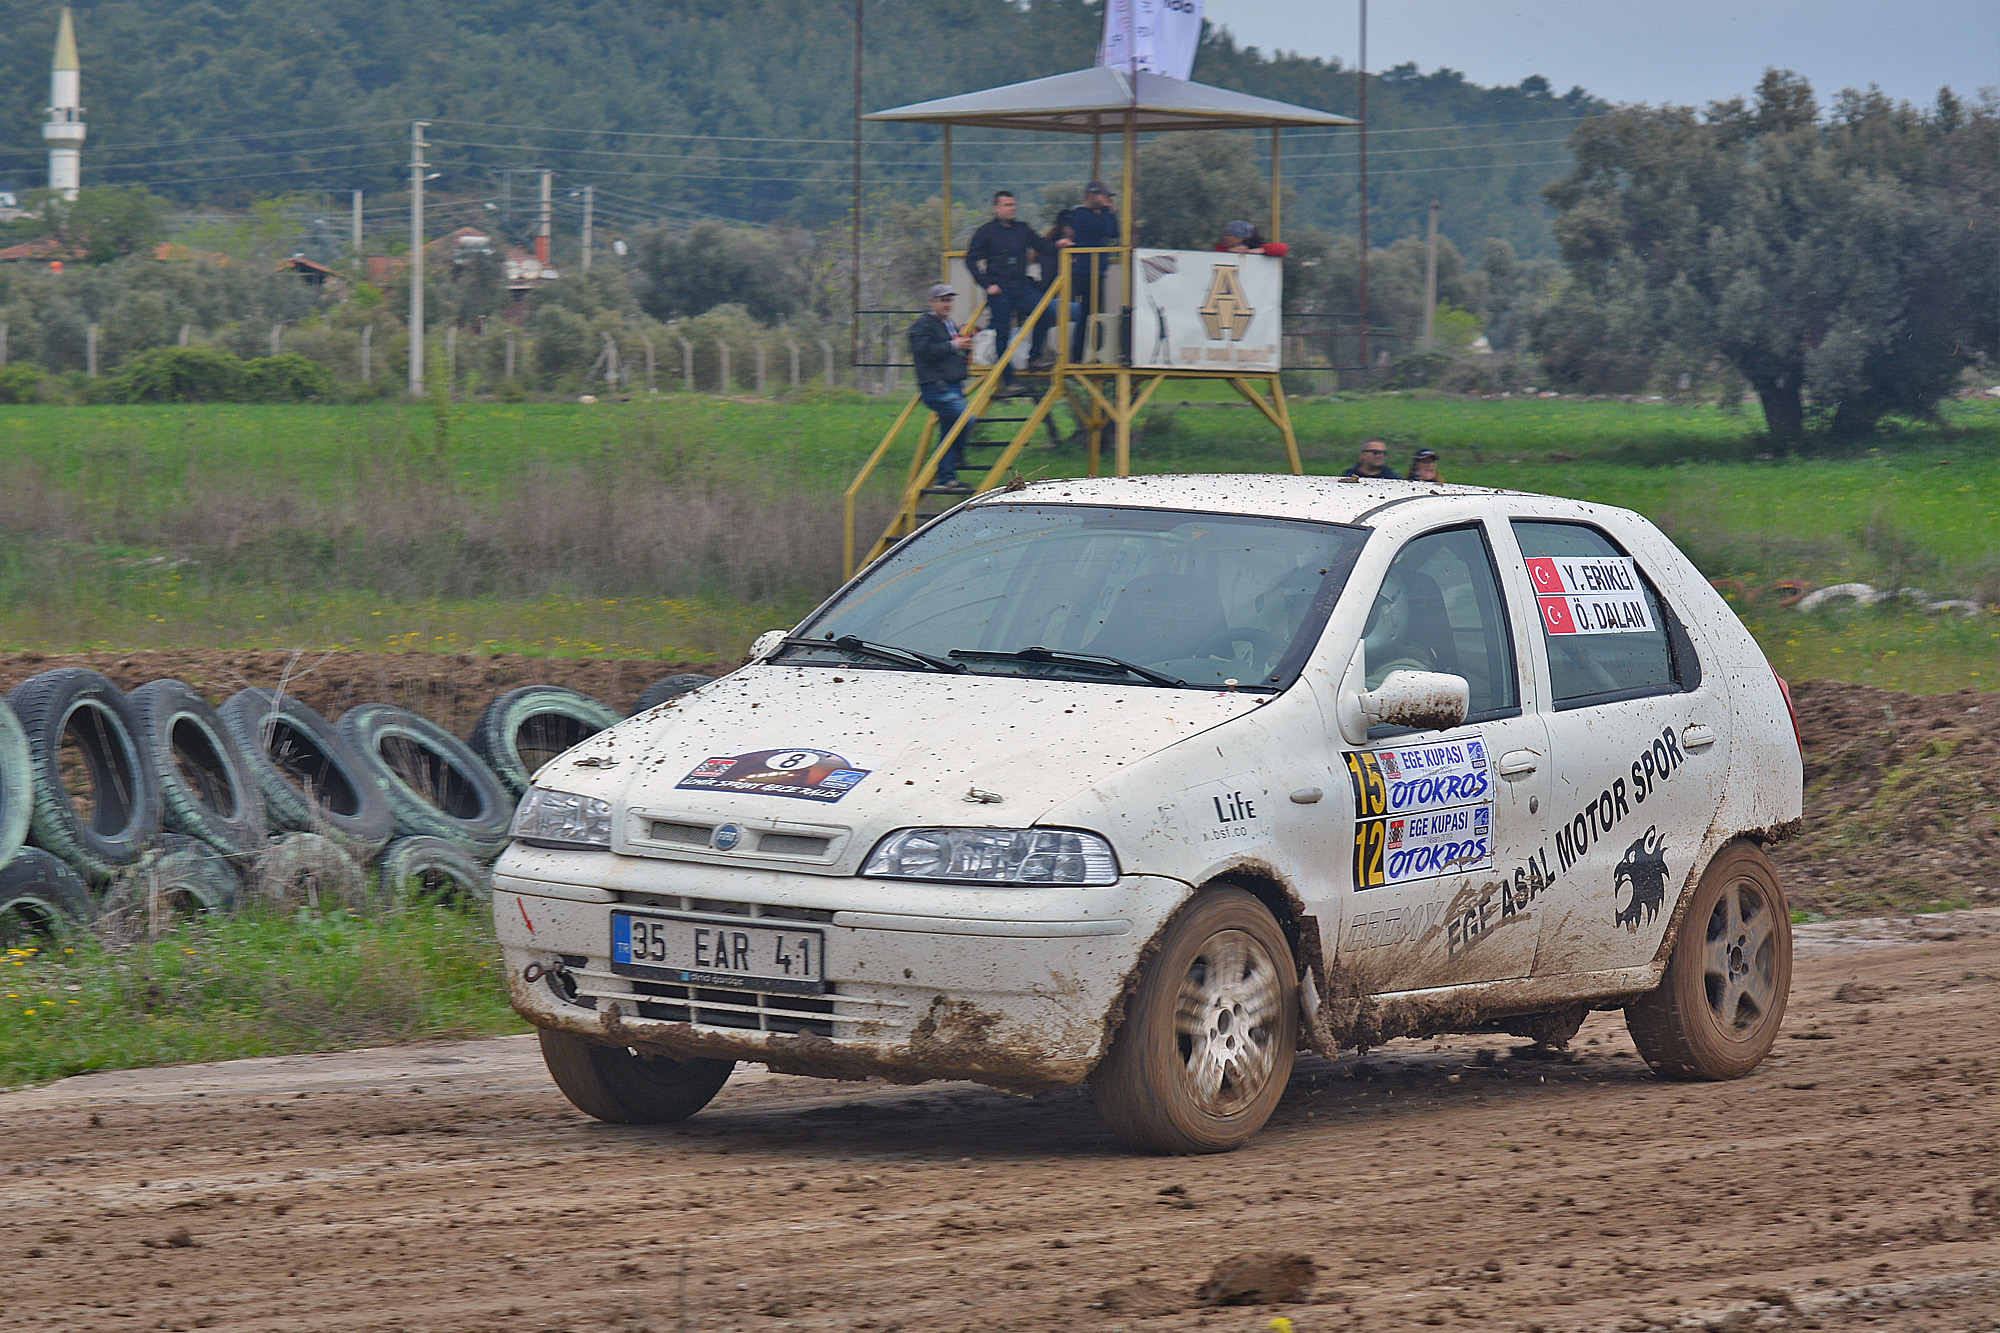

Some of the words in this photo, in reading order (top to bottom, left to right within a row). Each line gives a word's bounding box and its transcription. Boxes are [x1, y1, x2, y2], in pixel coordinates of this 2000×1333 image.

[1562, 565, 1584, 590] Y.
[1573, 597, 1595, 630] Ö.
[1593, 601, 1647, 629] DALAN
[778, 753, 808, 768] 8
[1400, 751, 1424, 770] EGE
[1424, 745, 1465, 767] KUPASI
[1348, 752, 1386, 815] 15
[1391, 769, 1489, 809] OTOKROS
[1408, 818, 1429, 838] EGE
[1430, 811, 1469, 834] KUPASI
[1501, 846, 1557, 920] ASAL
[1554, 777, 1630, 874] MOTOR
[1630, 725, 1685, 804] SPOR
[1356, 820, 1385, 888] 12
[1387, 837, 1488, 879] OTOKROS
[616, 942, 630, 954] TR
[633, 920, 666, 962] 35
[694, 928, 749, 971] EAR
[775, 935, 810, 976] 41
